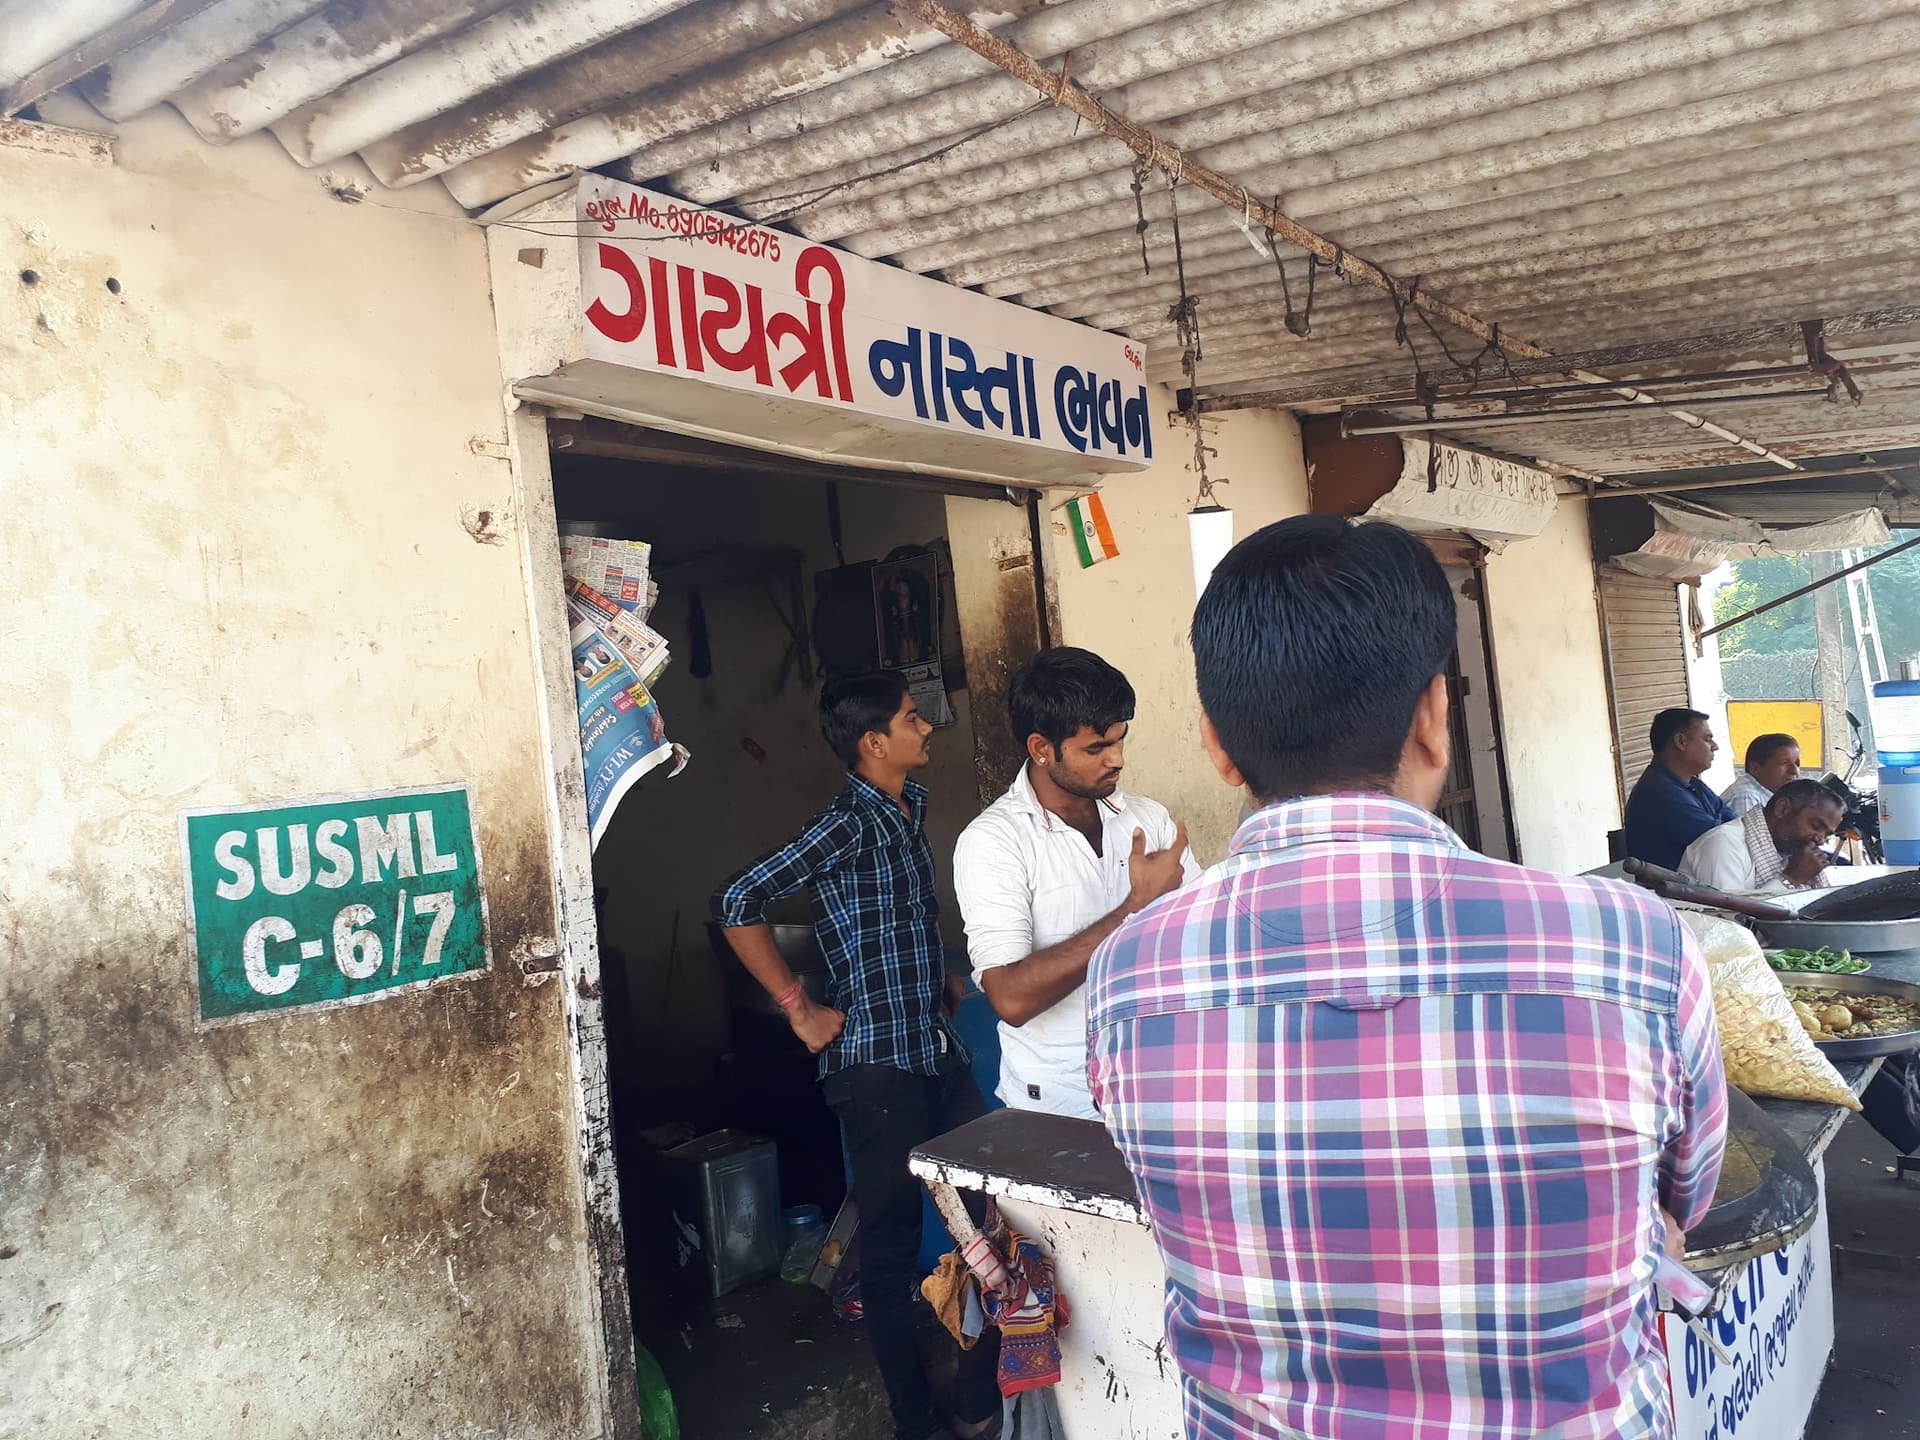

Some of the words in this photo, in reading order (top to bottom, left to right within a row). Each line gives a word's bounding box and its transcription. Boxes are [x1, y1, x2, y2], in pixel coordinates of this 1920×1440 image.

[585, 243, 854, 403] ગાયત્રી
[868, 326, 1041, 440] નાસ્તા
[1053, 365, 1153, 459] ભવન
[214, 810, 458, 901] SUSML
[242, 889, 456, 996] C-6/7
